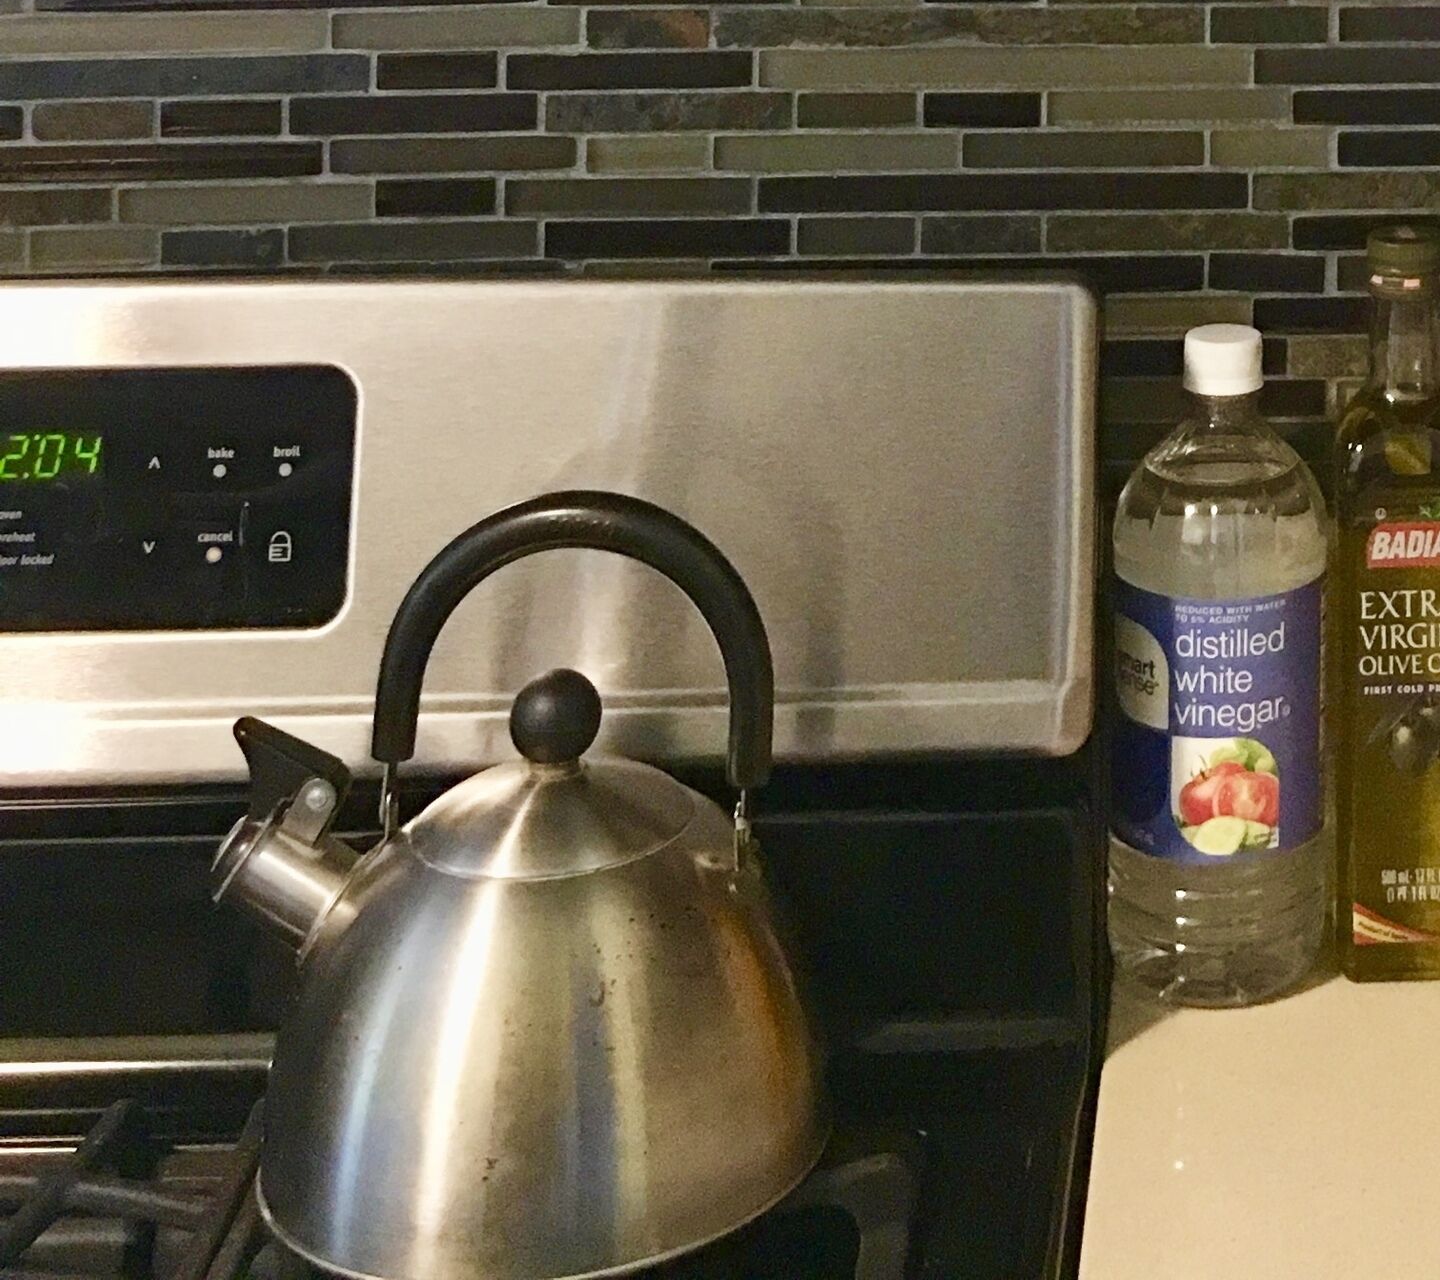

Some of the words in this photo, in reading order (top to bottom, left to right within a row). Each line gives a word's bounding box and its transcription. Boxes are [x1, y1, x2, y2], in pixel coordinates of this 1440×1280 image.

[208, 447, 235, 459] bake
[273, 445, 300, 457] broil
[198, 530, 233, 542] cancel
[21, 553, 55, 565] locked
[1175, 605, 1223, 614] REDUCED
[1227, 605, 1251, 614] WITH
[1256, 599, 1286, 612] WATER
[1175, 614, 1188, 623] TO
[1209, 614, 1250, 623] ACIDITY
[1175, 621, 1285, 659] distilled
[1359, 653, 1424, 676] OLIVE
[1175, 665, 1253, 694] white
[1364, 684, 1393, 695] FIRST
[1397, 684, 1425, 694] COLD
[1175, 696, 1284, 733] vinegar
